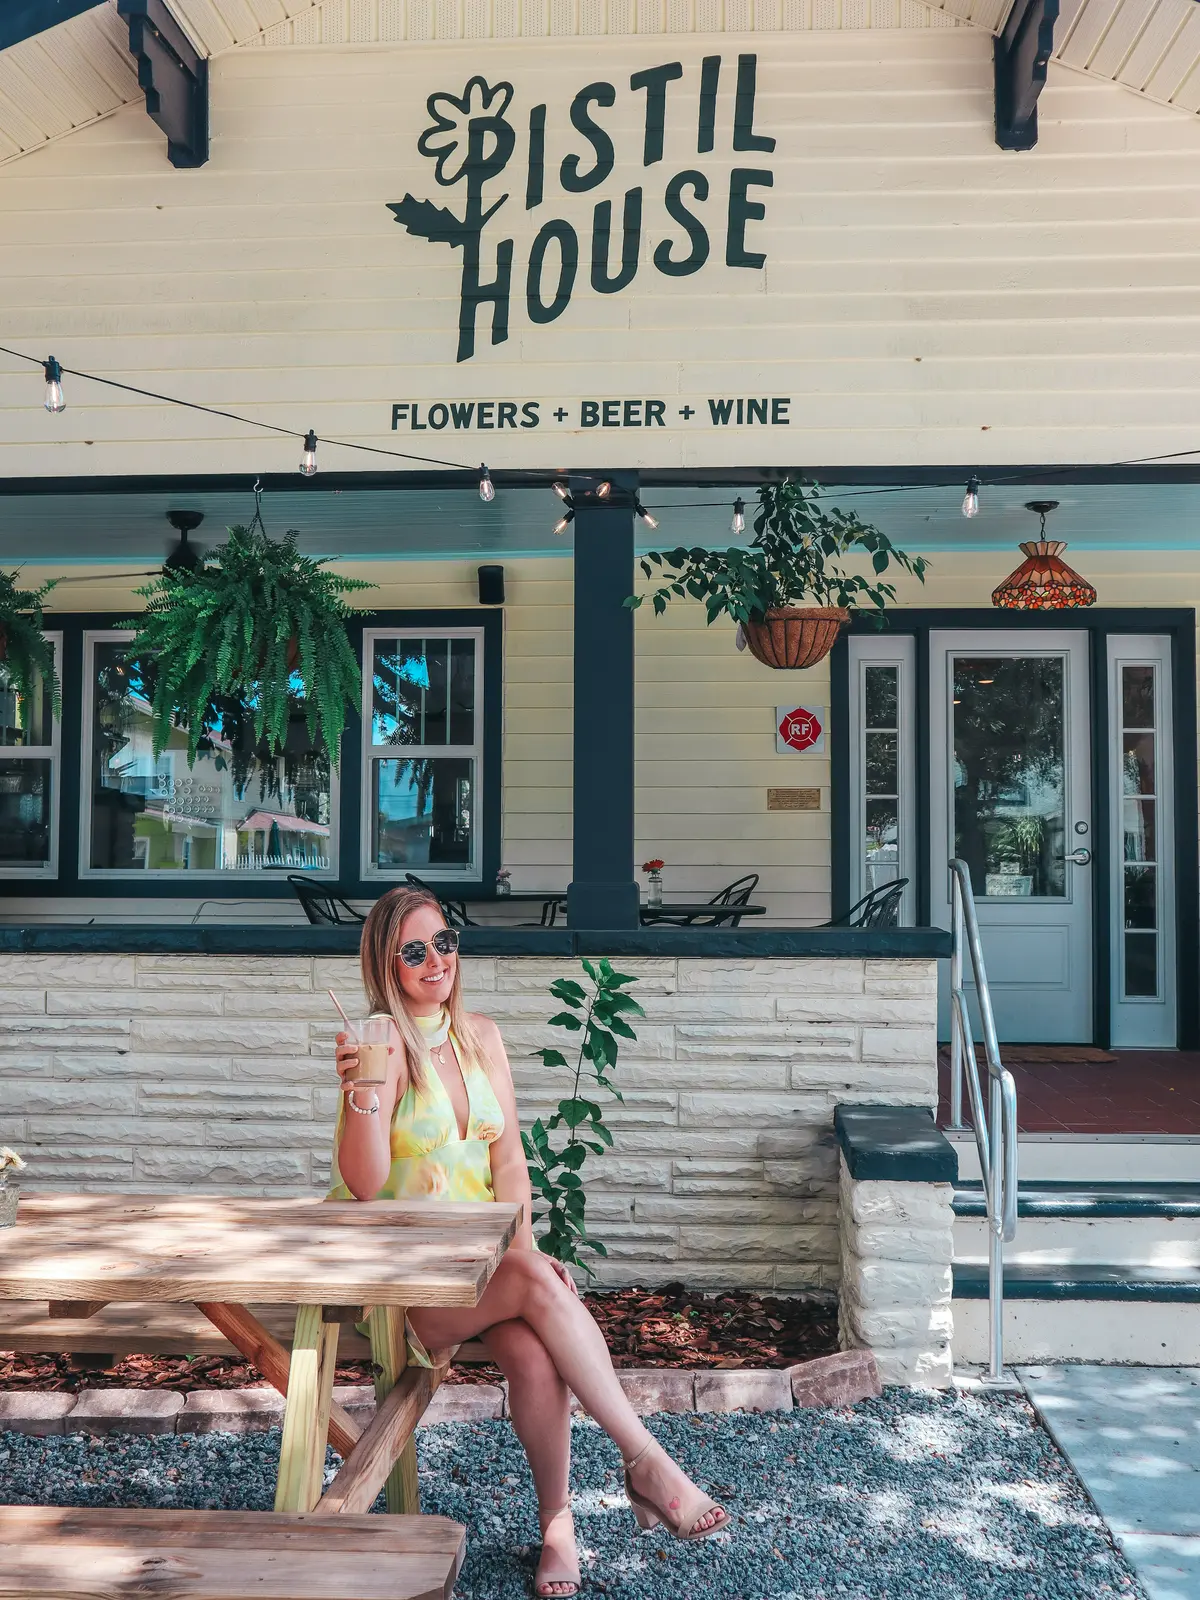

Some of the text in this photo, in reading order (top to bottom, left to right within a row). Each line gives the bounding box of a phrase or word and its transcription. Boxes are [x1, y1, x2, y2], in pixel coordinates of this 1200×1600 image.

[464, 53, 777, 211] PISTIL
[456, 167, 774, 364] HOUSE
[391, 402, 540, 431] FLOWERS
[580, 399, 666, 428] BEER
[707, 397, 791, 426] WINE
[791, 723, 810, 735] RF
